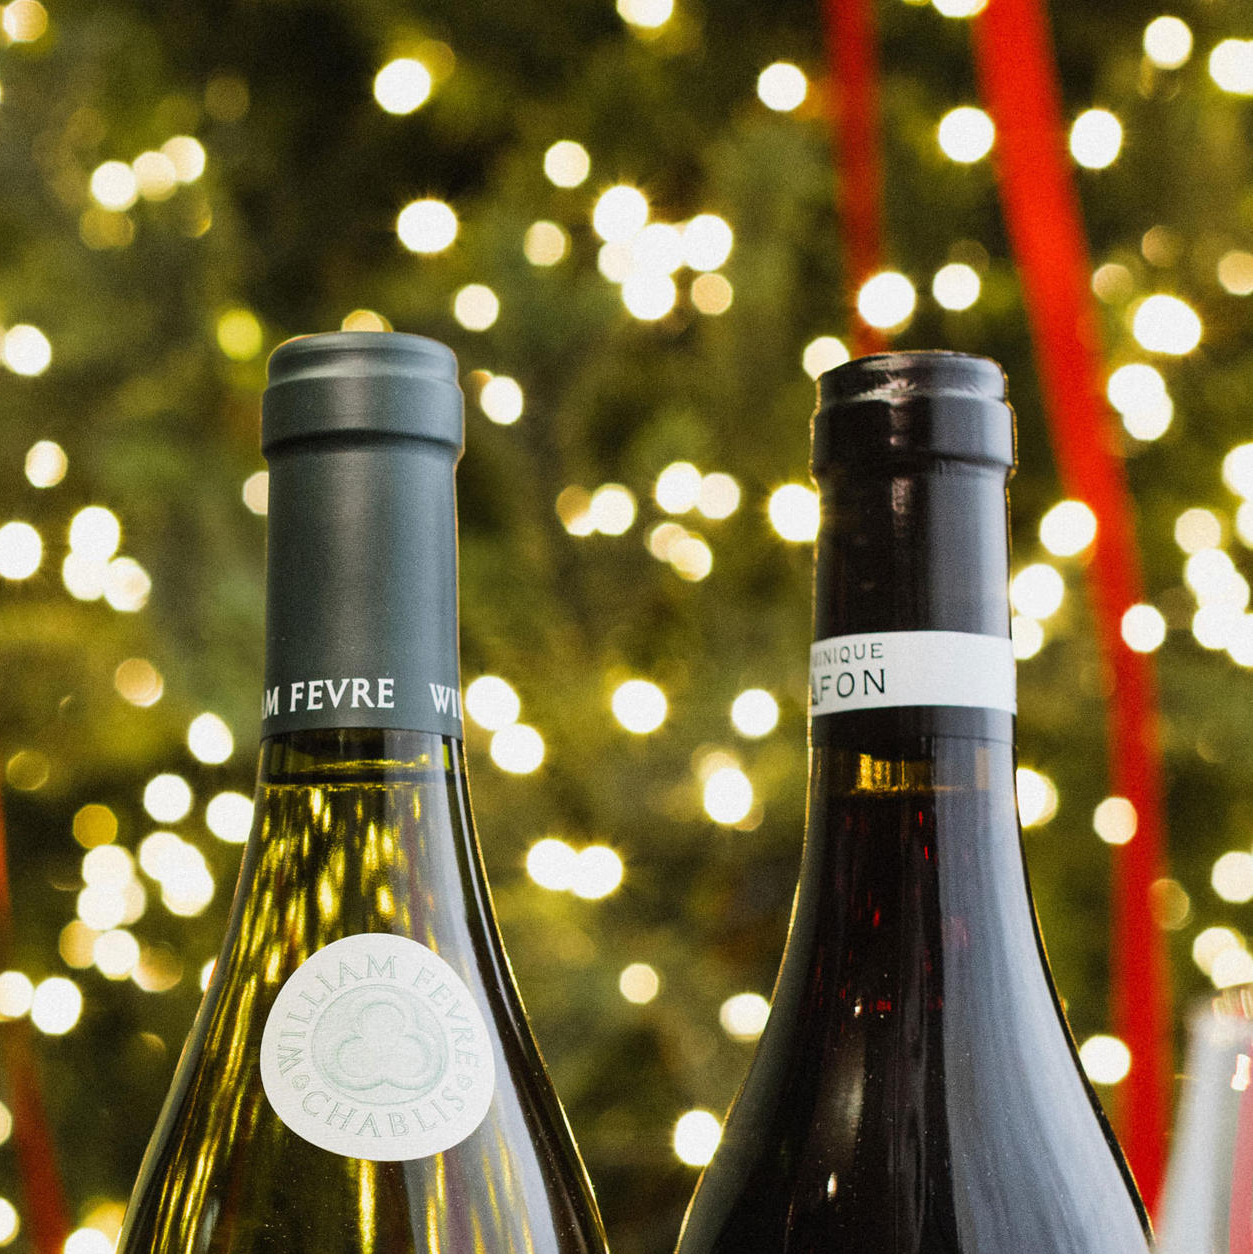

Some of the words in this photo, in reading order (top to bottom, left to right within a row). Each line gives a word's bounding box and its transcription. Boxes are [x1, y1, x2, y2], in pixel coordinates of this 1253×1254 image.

[288, 676, 394, 714] FEVRE
[278, 953, 397, 1077] WILLIAM
[412, 966, 481, 1070] FEVRE
[302, 1088, 465, 1138] CHABLIS
